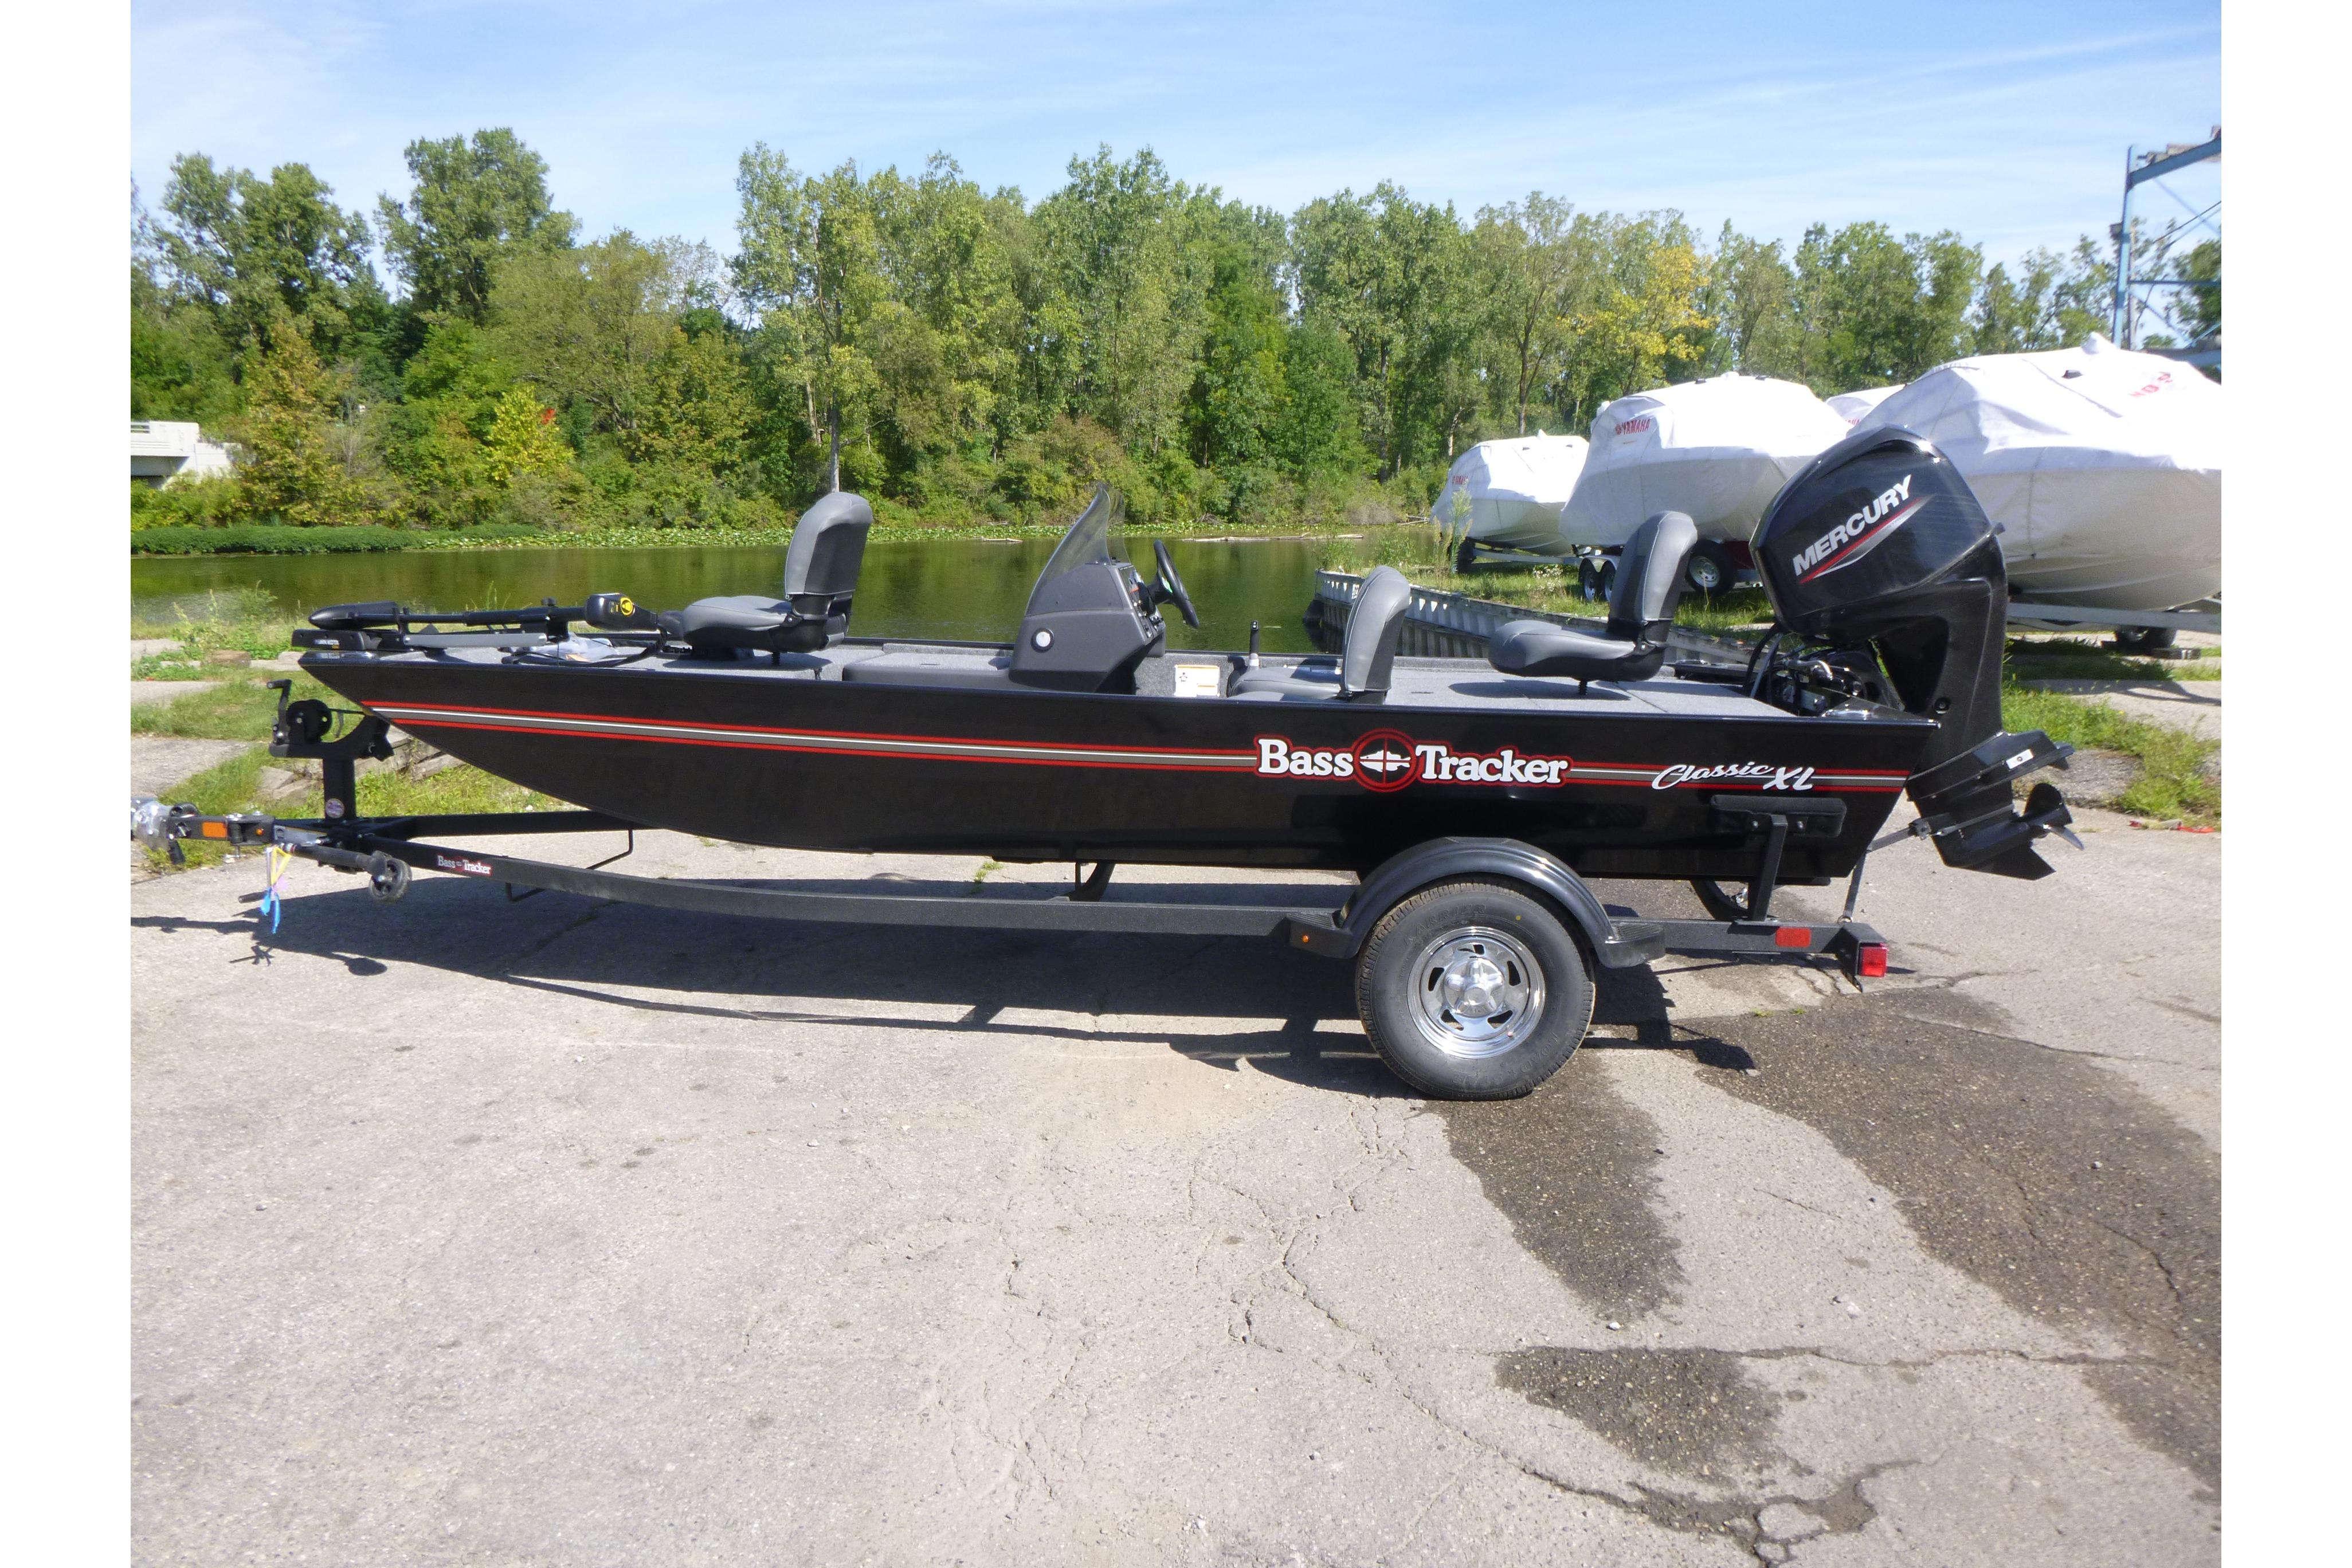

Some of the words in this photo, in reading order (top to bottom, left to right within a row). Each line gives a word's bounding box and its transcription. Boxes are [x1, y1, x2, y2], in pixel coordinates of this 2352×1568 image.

[1621, 418, 1651, 435] YAMAHA
[1793, 474, 1911, 577] MERCURY
[1258, 739, 1353, 777] Bass
[1416, 745, 1569, 784] Tracker
[1651, 761, 1775, 790] Classic
[1762, 766, 1815, 791] XL
[437, 855, 456, 868] Bass
[462, 860, 491, 874] Tracker
